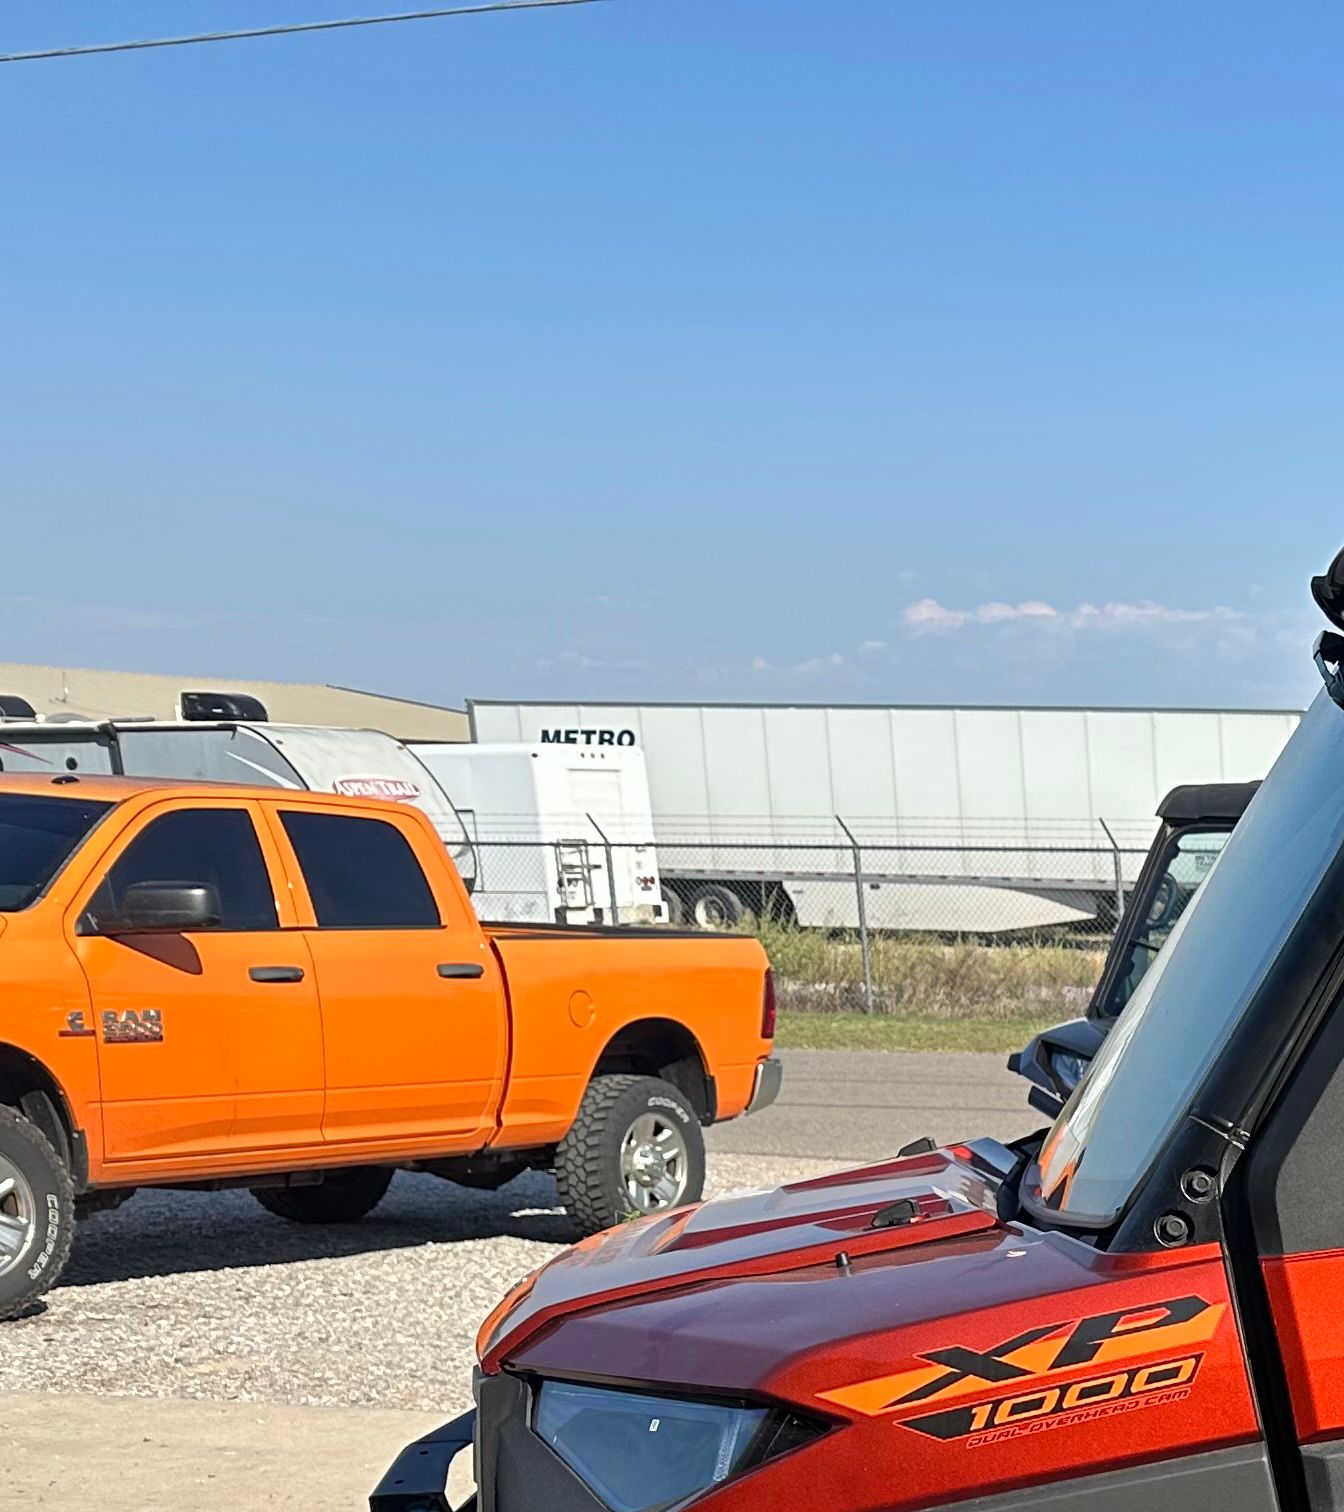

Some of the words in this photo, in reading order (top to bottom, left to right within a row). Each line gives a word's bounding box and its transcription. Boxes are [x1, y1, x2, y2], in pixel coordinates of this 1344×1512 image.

[541, 729, 636, 746] METRO
[27, 1193, 59, 1280] COOPER
[880, 1295, 1210, 1409] XP
[968, 1356, 1198, 1431] 1000
[968, 1428, 1024, 1448] DUAL
[1030, 1402, 1139, 1432] OVERHEAD
[1144, 1389, 1190, 1406] CAM
